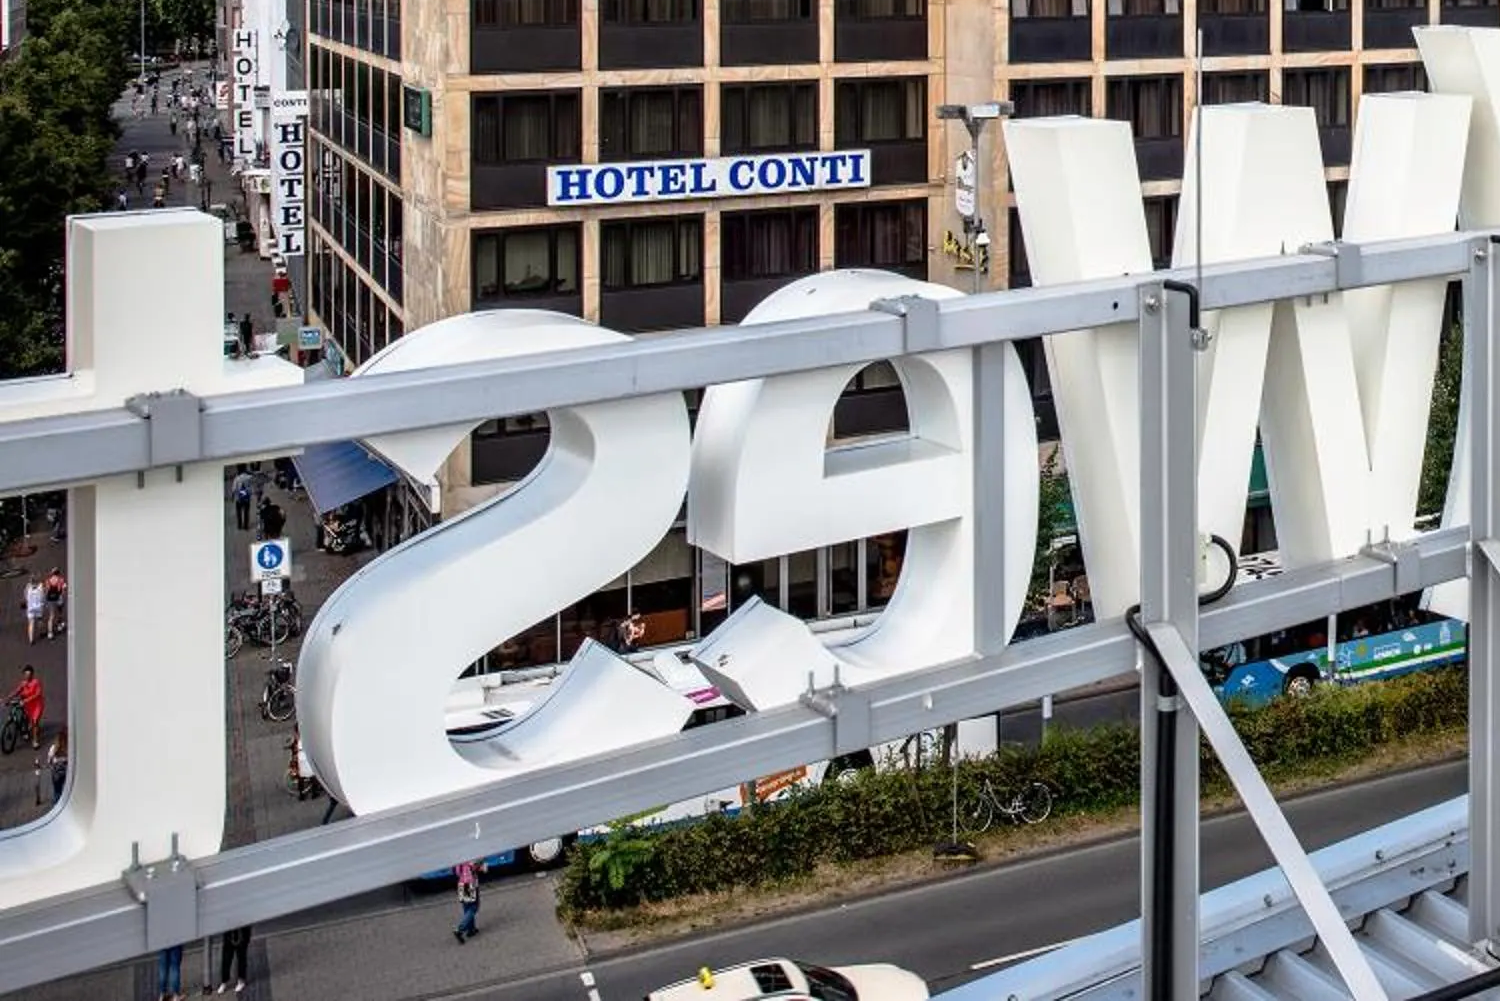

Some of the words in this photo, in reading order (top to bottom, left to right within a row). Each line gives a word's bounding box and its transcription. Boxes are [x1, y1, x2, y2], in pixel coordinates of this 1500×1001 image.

[236, 30, 253, 154] HOTEL
[273, 98, 308, 108] CONTI
[279, 122, 303, 254] HOTEL
[556, 162, 716, 201] HOTEL
[729, 154, 865, 190] CONTI
